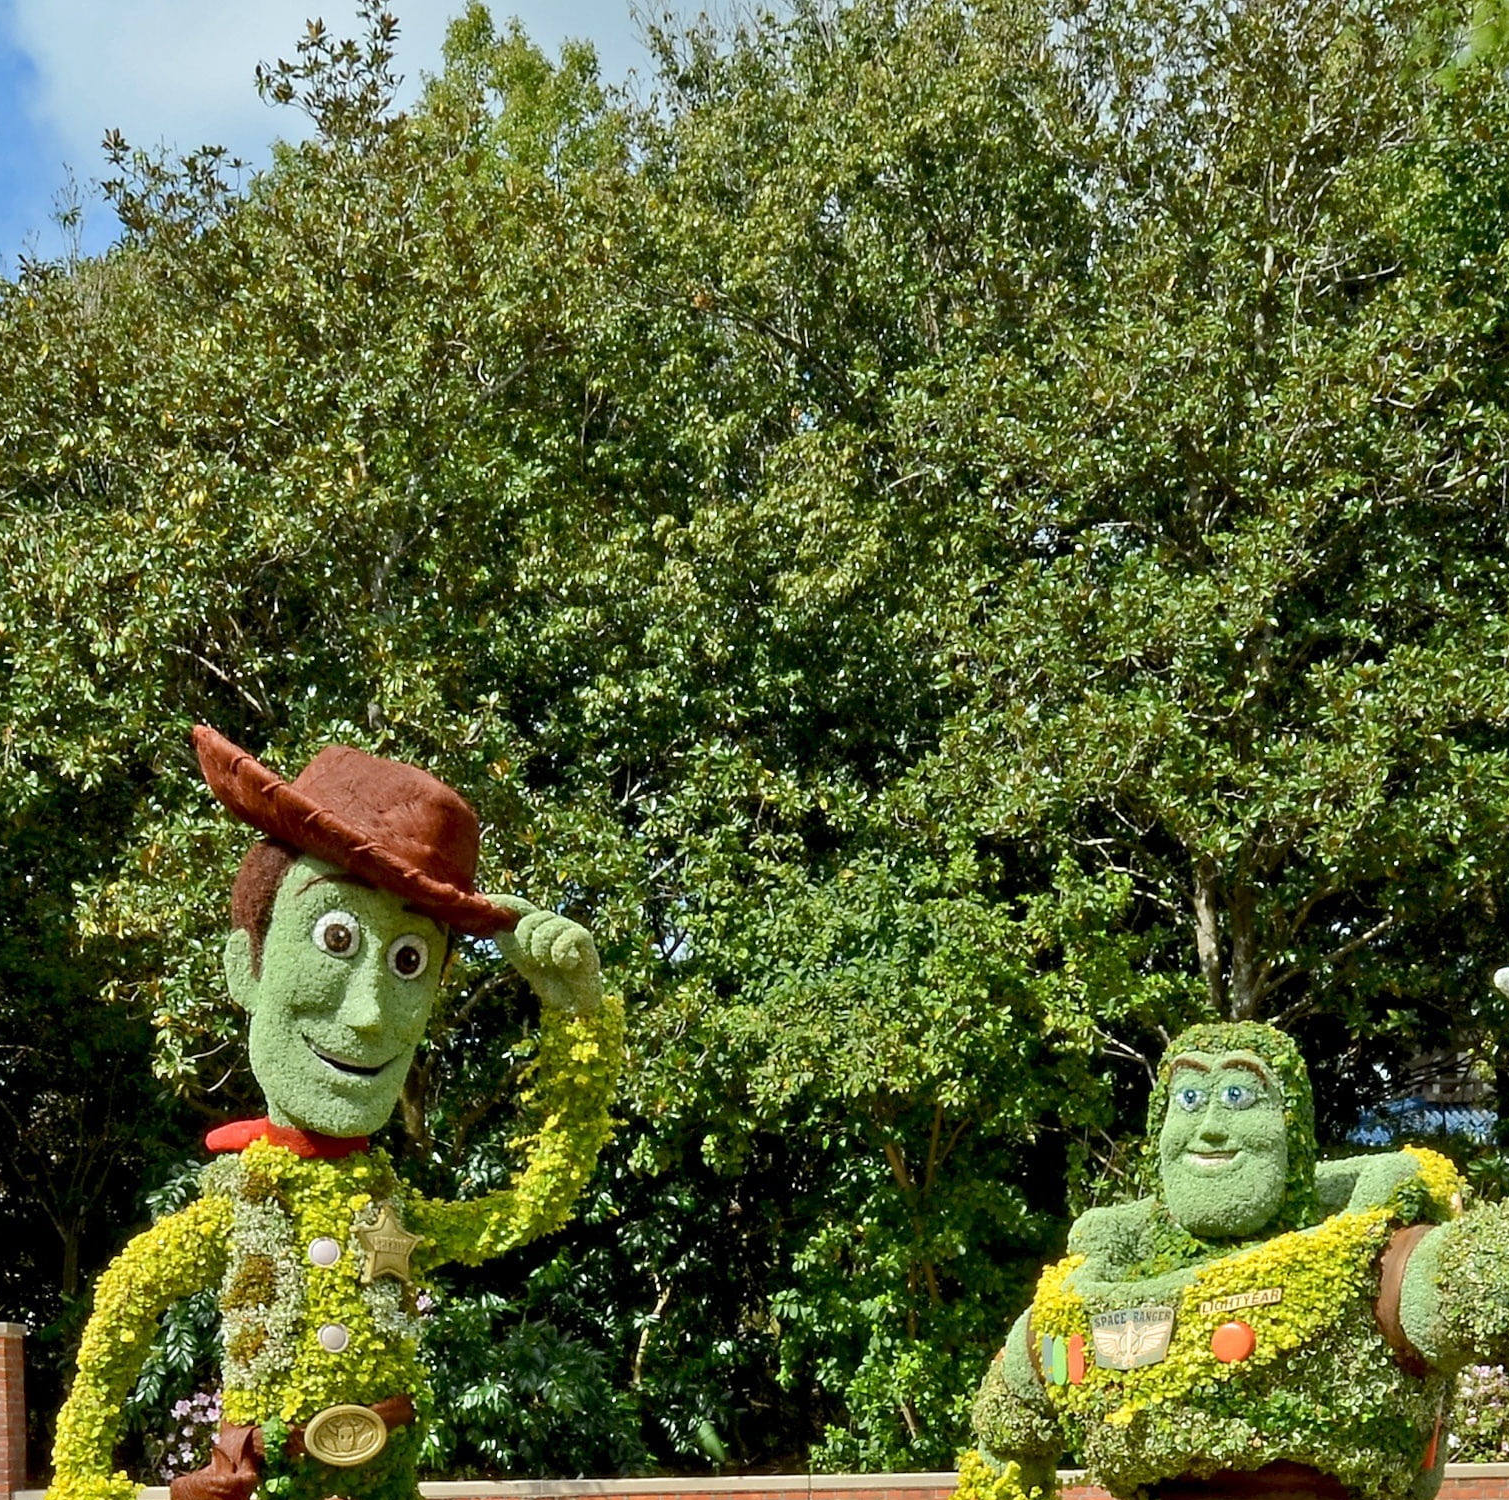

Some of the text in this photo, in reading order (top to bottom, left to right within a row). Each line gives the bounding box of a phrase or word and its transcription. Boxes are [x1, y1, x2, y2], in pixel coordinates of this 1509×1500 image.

[1202, 1288, 1280, 1314] LIGHTYEAR
[1094, 1309, 1172, 1329] SPACE RANGER
